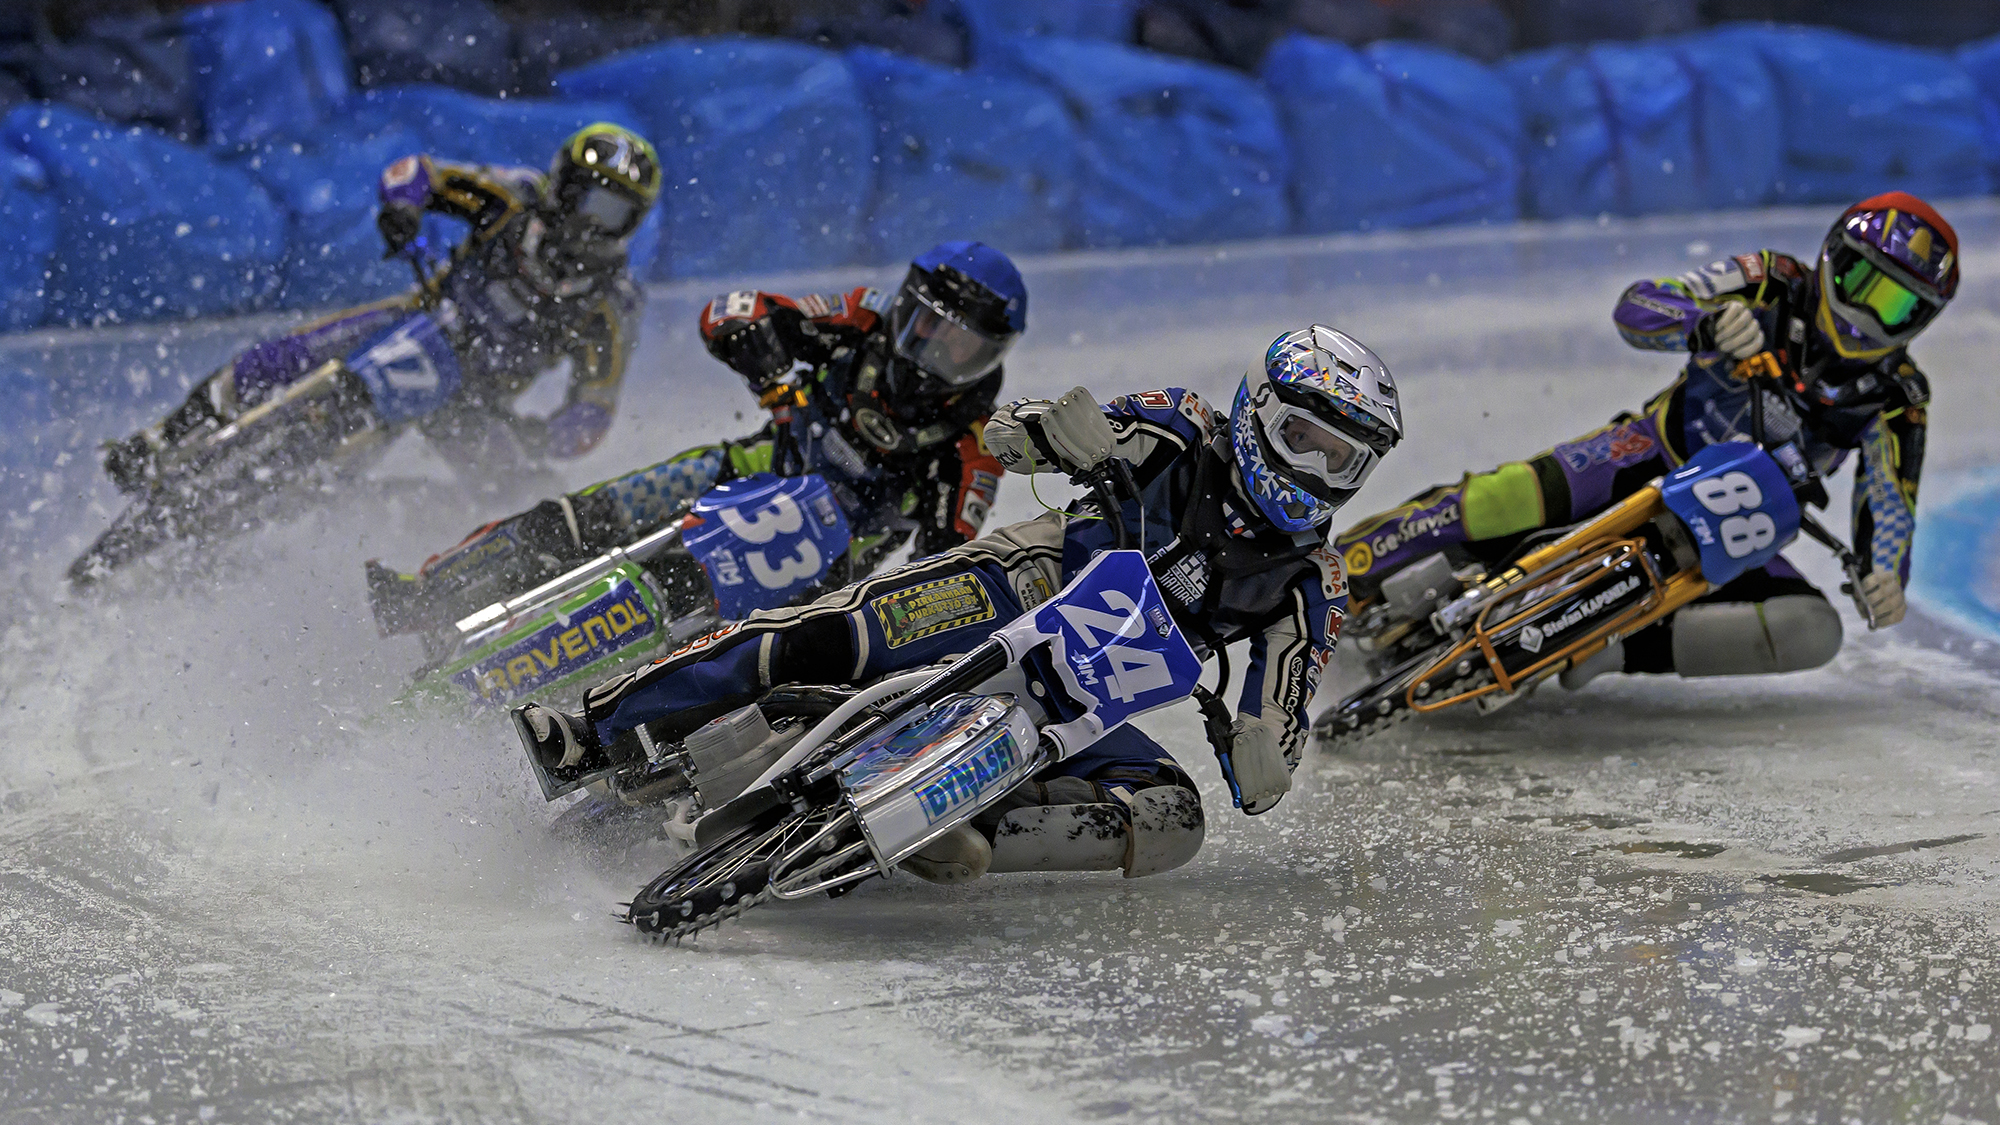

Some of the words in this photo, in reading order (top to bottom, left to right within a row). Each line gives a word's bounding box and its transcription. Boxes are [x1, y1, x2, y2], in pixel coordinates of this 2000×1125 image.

[717, 492, 822, 590] 33
[1692, 471, 1776, 559] 88
[709, 549, 744, 586] FIM
[964, 595, 979, 606] OY
[476, 597, 648, 698] RAVENOL
[1055, 590, 1174, 703] 24
[1285, 676, 1301, 713] WACO
[923, 733, 1017, 817] DYNASET
